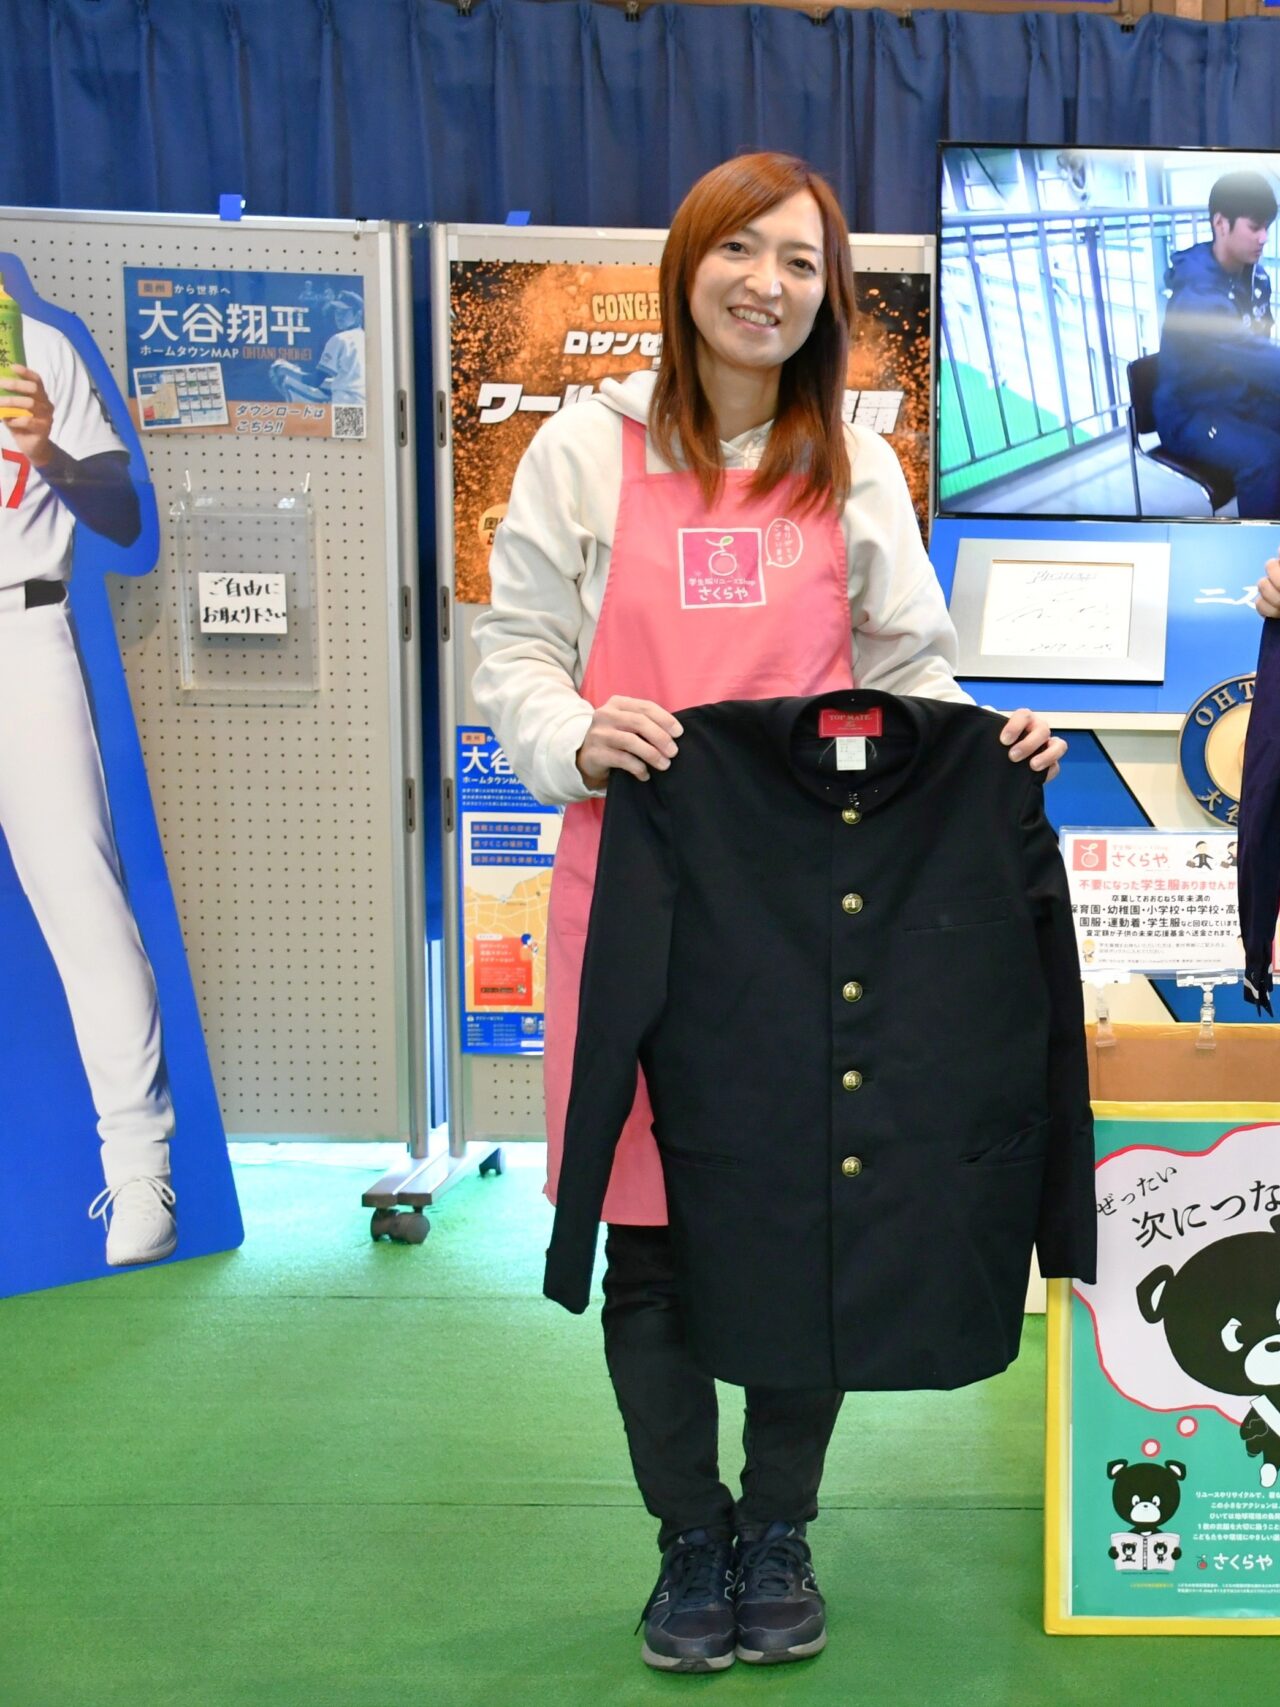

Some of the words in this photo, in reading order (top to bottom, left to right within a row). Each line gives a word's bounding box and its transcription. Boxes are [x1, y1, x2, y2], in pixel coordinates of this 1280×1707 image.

[139, 300, 311, 346] 大谷翔平
[140, 345, 239, 359] ホームタウンMAP
[235, 404, 325, 419] ダウンロードは
[209, 577, 280, 598] ご自由に
[698, 586, 749, 601] さくらや
[203, 605, 287, 624] お取り下さい
[1111, 851, 1169, 868] さくらや
[1111, 894, 1211, 902] 卒業しておおむね5年未満の
[1071, 904, 1239, 915] 保育園・幼稚園・小学校・中学校・高
[1096, 1163, 1179, 1217] ぜったい
[1213, 1553, 1274, 1571] さくらや
